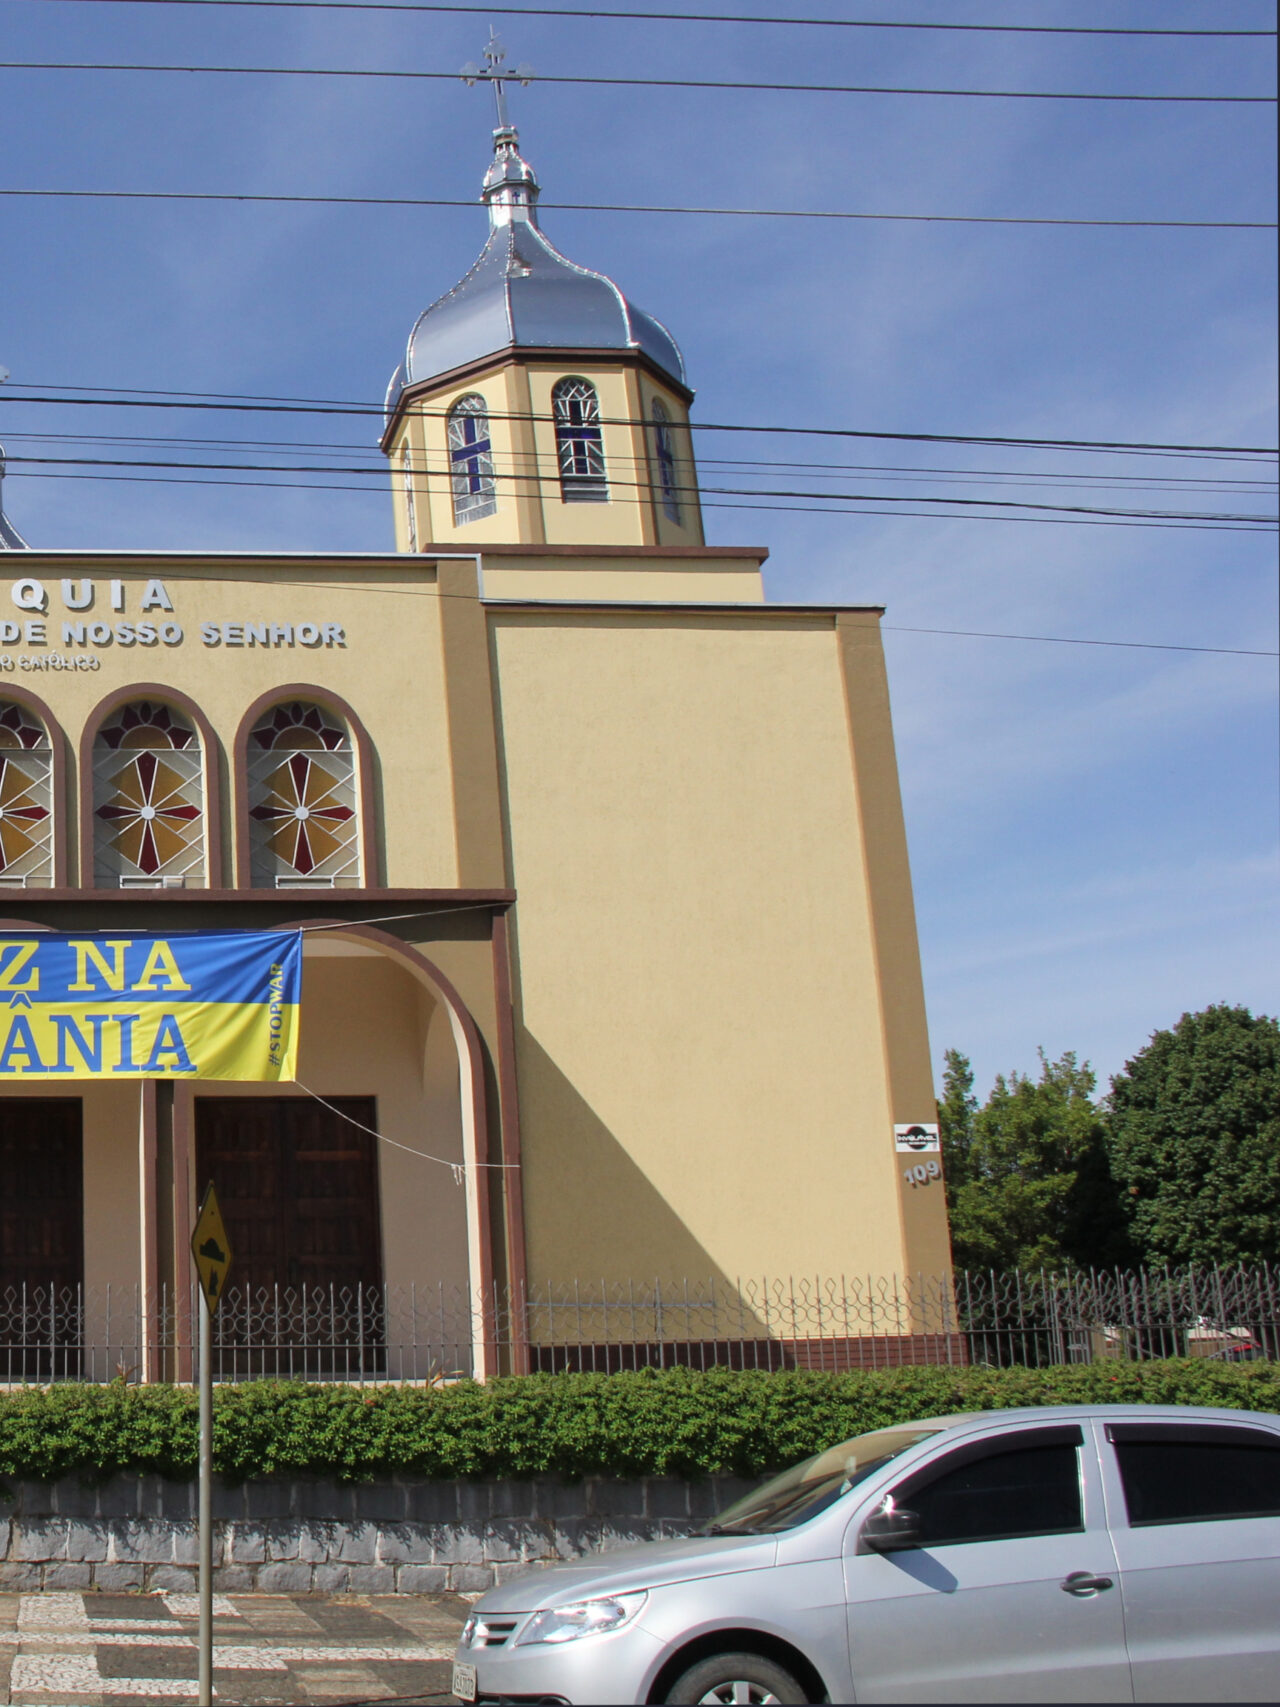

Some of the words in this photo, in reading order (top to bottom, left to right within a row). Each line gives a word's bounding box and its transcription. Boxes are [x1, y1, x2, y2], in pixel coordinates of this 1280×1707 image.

[61, 620, 184, 645] NOSSO
[200, 621, 346, 645] SENHOR
[67, 939, 192, 992] NA
[269, 962, 284, 1067] #STOPWAR
[903, 1160, 940, 1185] 109
